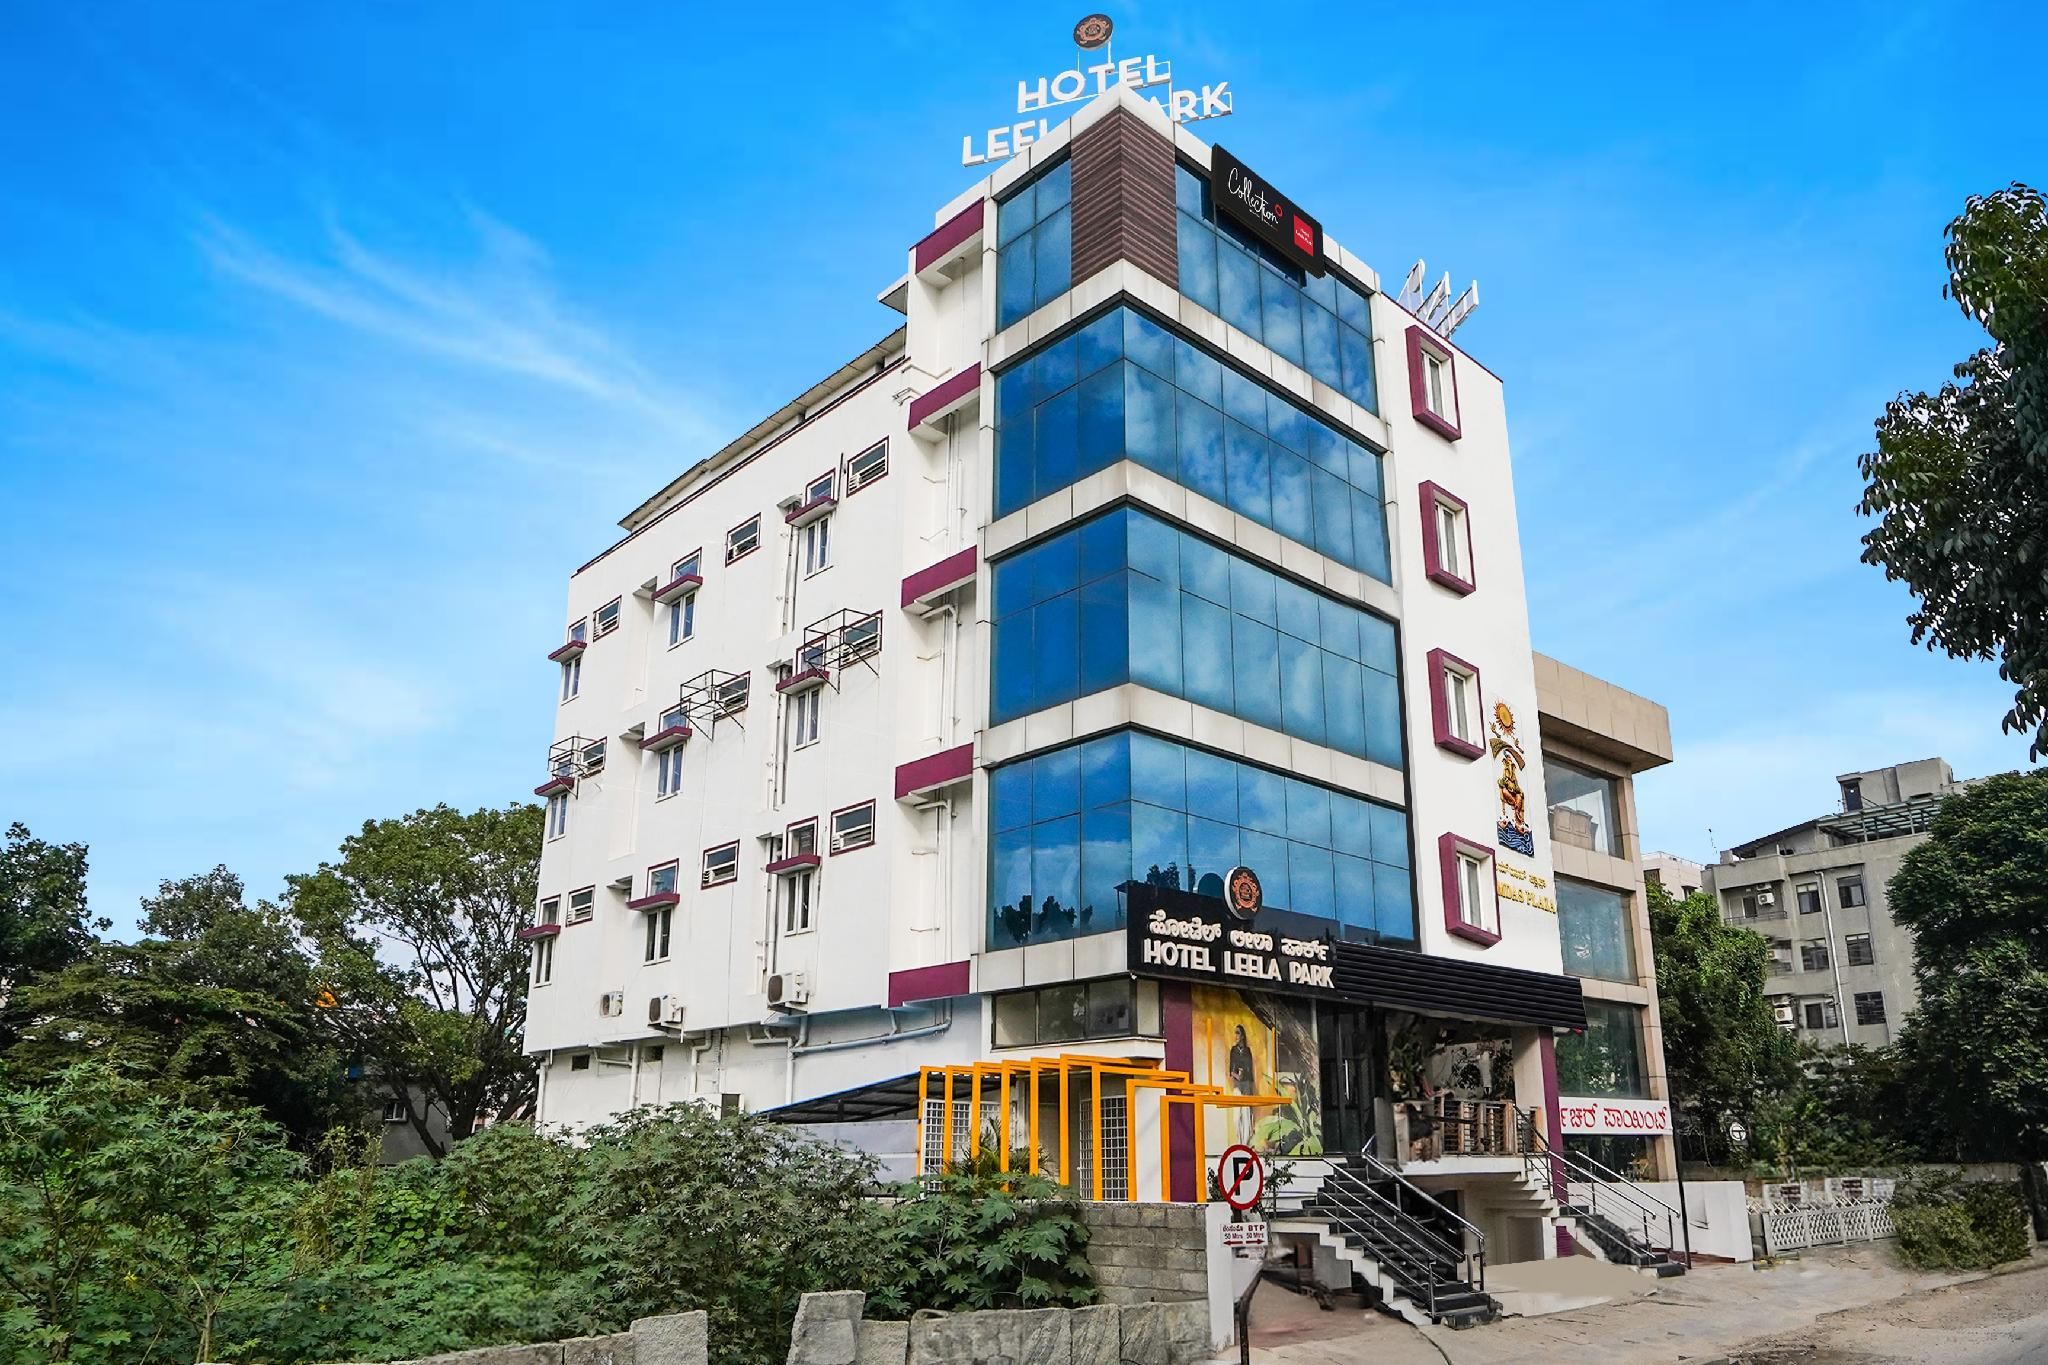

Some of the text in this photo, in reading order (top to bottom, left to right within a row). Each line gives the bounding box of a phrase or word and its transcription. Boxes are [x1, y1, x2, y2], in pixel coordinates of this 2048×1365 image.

[1017, 55, 1170, 113] HOTEL
[1228, 167, 1279, 224] Collection
[1143, 938, 1335, 989] HOTEL LEELA PARK
